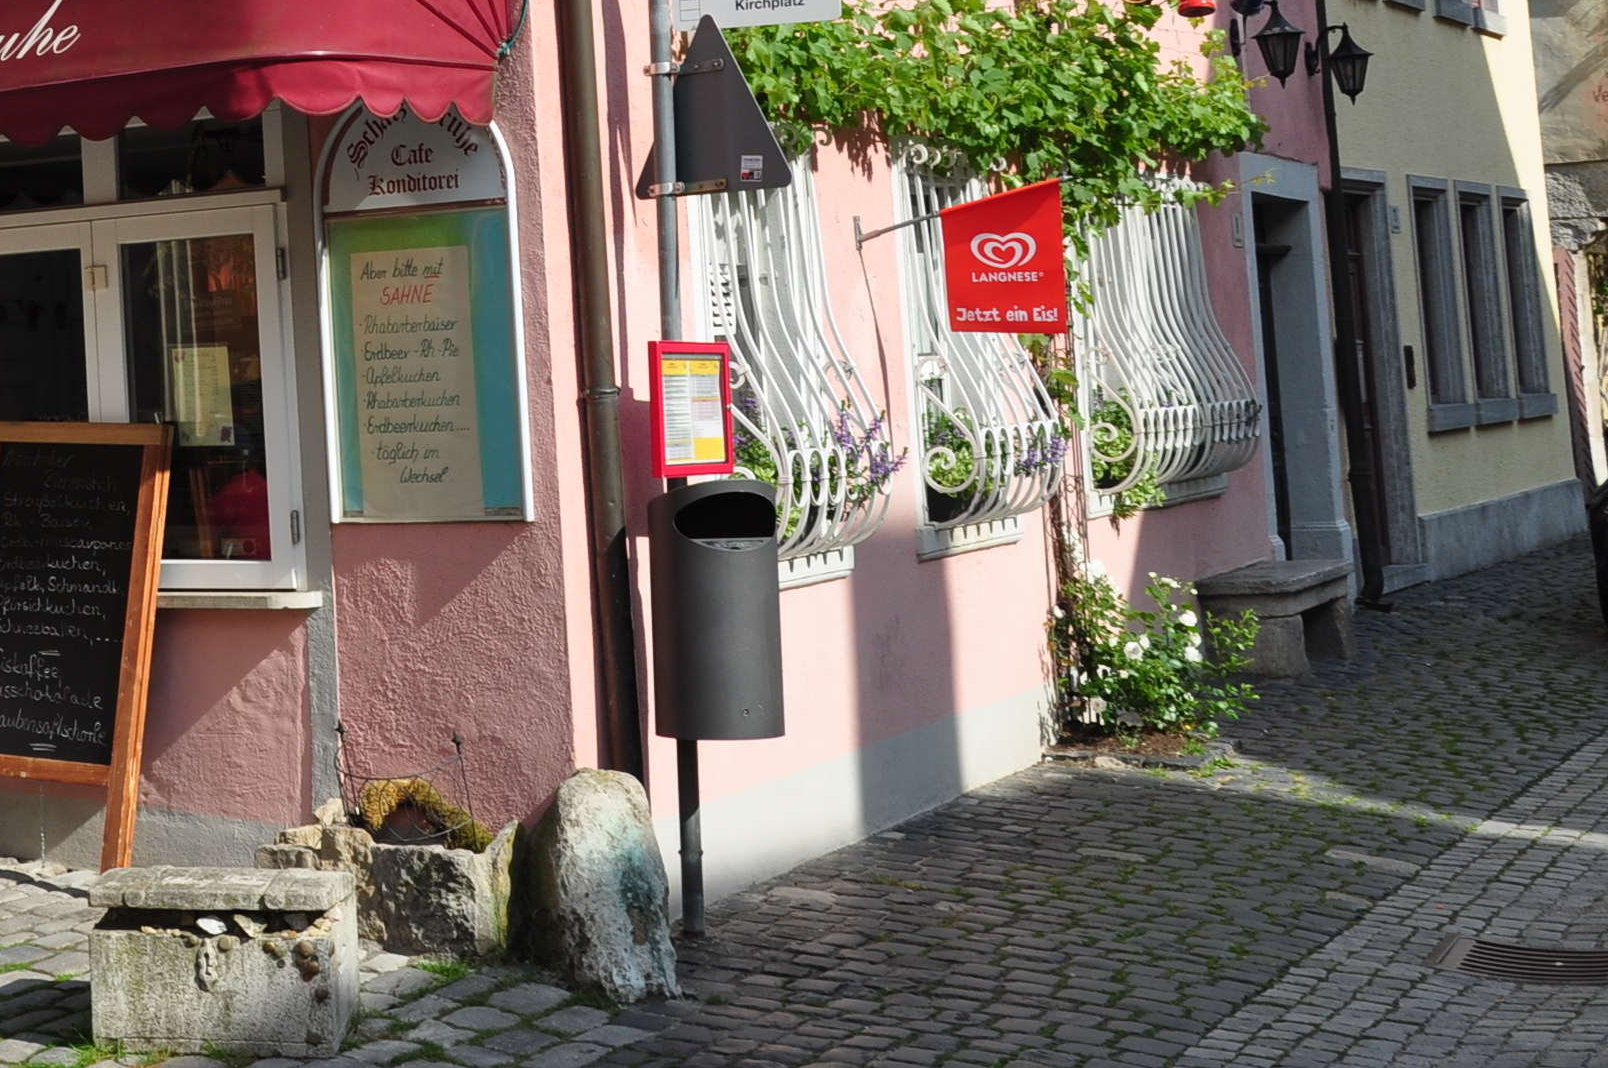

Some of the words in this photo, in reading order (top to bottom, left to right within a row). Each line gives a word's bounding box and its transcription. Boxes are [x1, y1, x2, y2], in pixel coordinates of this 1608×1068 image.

[391, 143, 434, 167] Cafe
[367, 169, 460, 196] Konditorei
[360, 261, 387, 281] Aber
[393, 258, 418, 278] bitte
[424, 258, 444, 276] mit
[971, 272, 1039, 283] LANGNESE
[379, 284, 435, 306] SAHNE
[956, 307, 1002, 322] Jetzt
[1006, 305, 1029, 322] ein
[1033, 305, 1059, 322] Eis!
[377, 441, 419, 465] täglich
